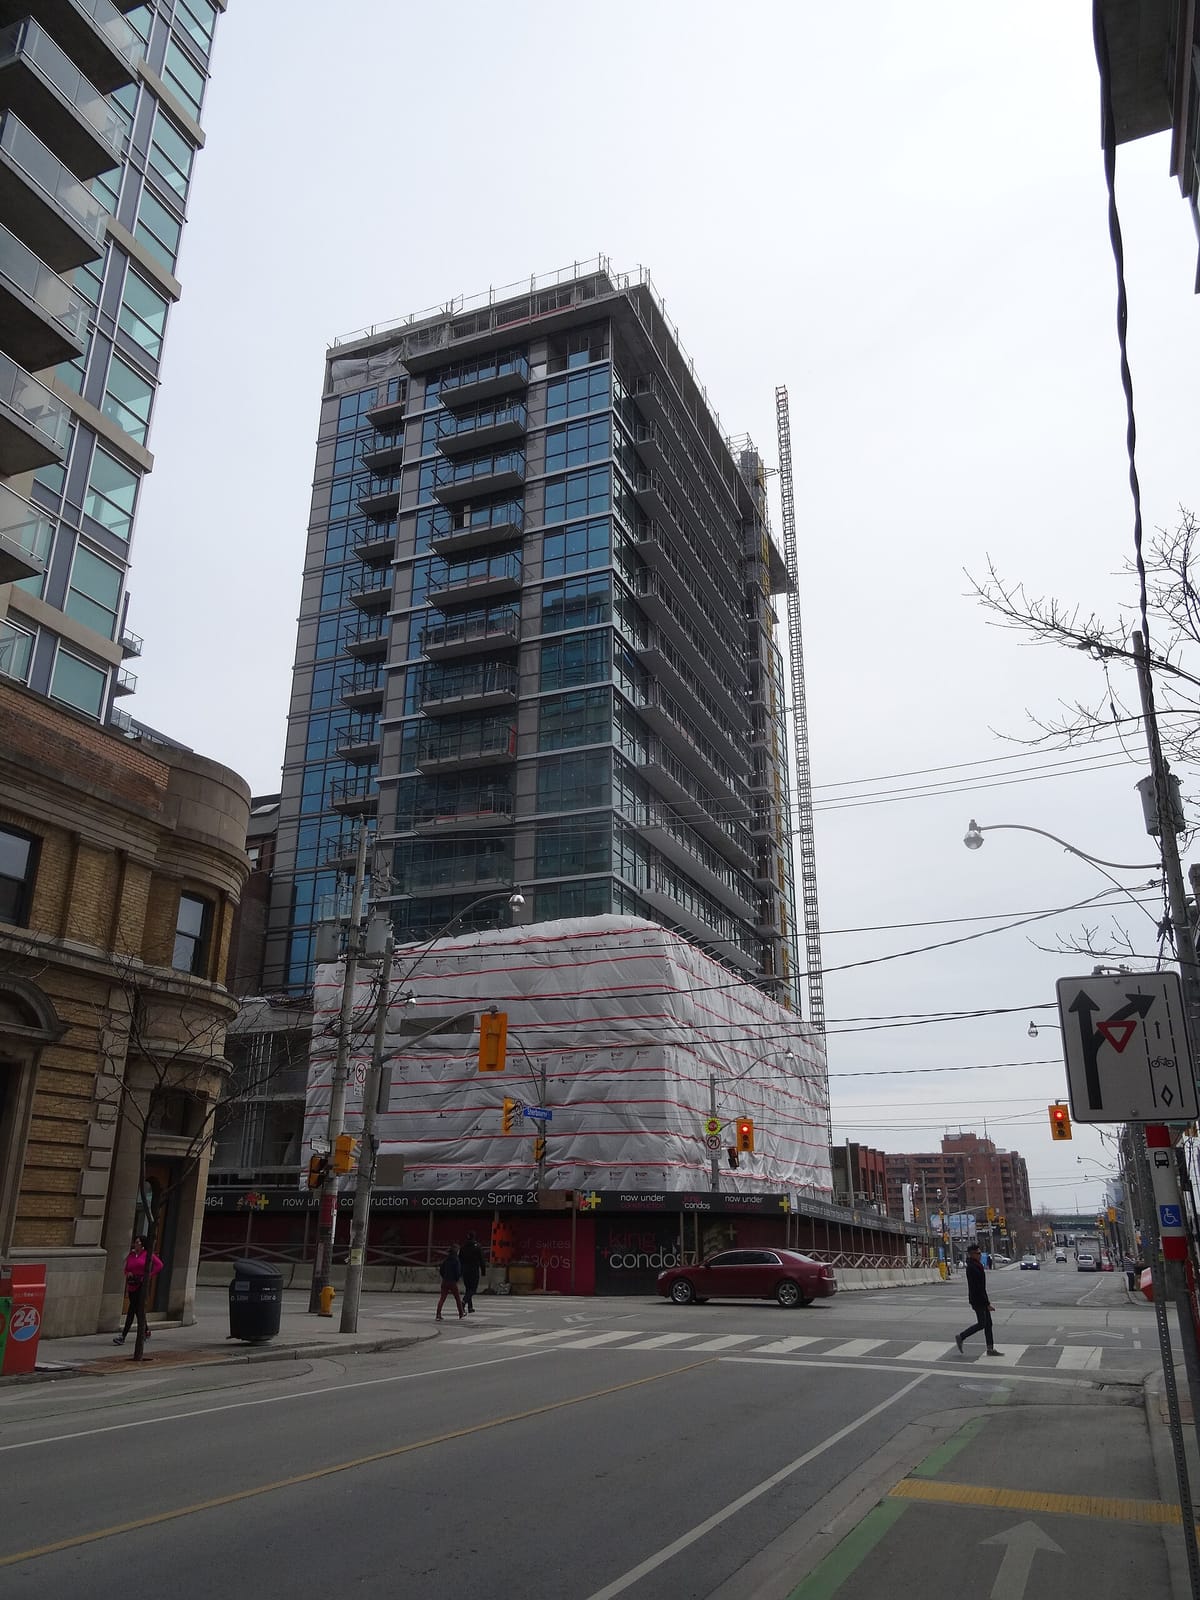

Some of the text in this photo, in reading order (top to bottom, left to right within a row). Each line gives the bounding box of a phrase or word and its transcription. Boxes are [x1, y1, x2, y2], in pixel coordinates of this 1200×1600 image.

[282, 1198, 304, 1207] now
[340, 1195, 409, 1207] coruction
[421, 1196, 485, 1208] occupancy
[487, 1192, 523, 1206] Spring
[620, 1193, 665, 1202] now under
[724, 1195, 764, 1204] now under
[684, 1201, 711, 1210] condos
[13, 1309, 37, 1328] 24
